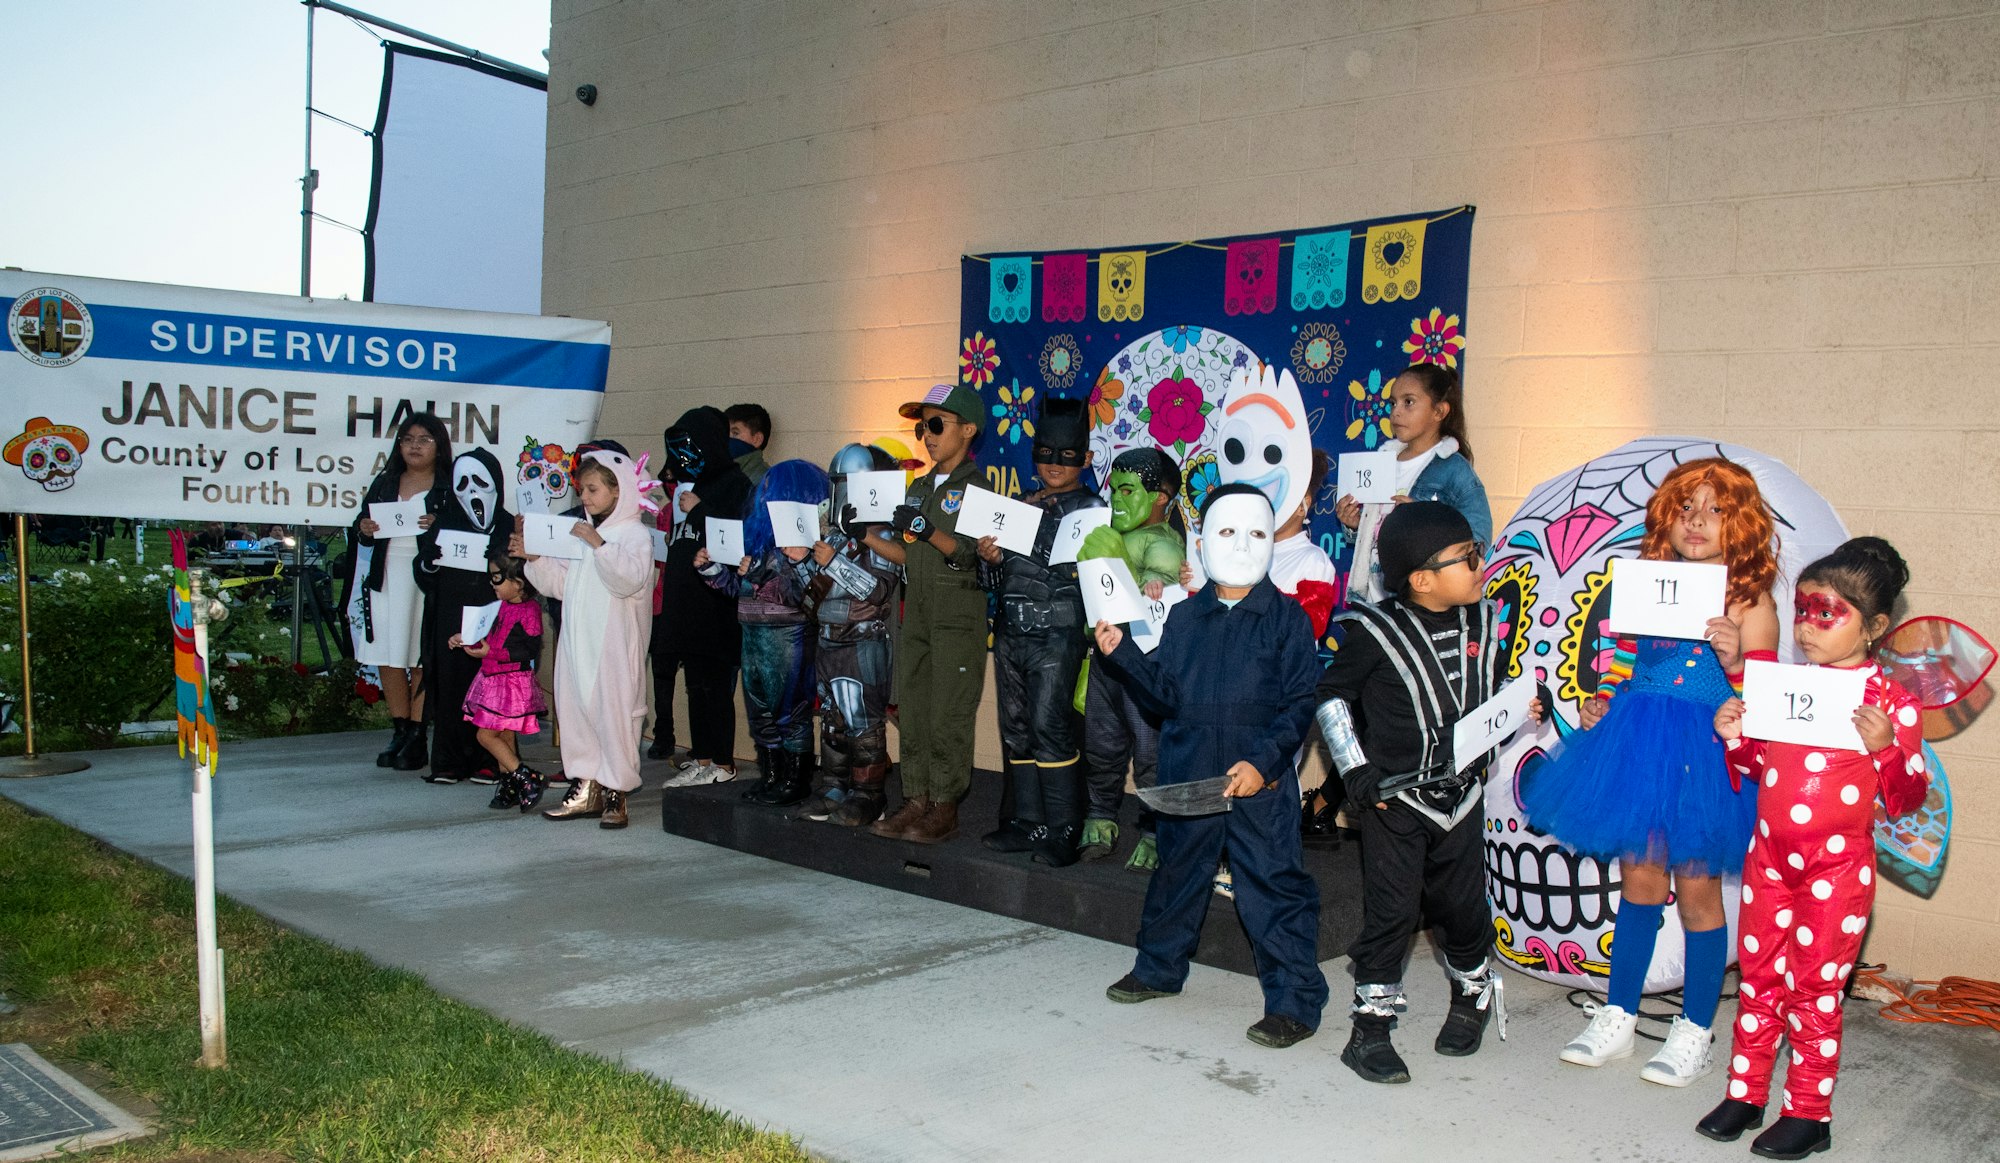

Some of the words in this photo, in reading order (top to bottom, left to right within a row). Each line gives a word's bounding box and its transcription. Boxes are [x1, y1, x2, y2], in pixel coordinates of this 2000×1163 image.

[13, 292, 35, 312] COUNTY
[64, 294, 89, 317] ANGELES
[150, 320, 457, 372] SUPERVISOR
[31, 355, 72, 365] CALIFORNIA
[102, 380, 317, 435] JANICE
[101, 437, 227, 473] County
[244, 446, 279, 471] of
[296, 448, 354, 475] Los
[986, 465, 1022, 498] DIA
[1356, 469, 1372, 488] 18
[182, 476, 289, 506] Fourth
[523, 490, 533, 506] 13
[869, 489, 878, 507] 2
[394, 513, 404, 527] 8
[796, 517, 805, 533] 6
[992, 511, 1006, 531] 4
[1071, 520, 1082, 540] 5
[547, 524, 555, 540] 1
[718, 529, 726, 545] 7
[453, 543, 468, 558] 14
[1101, 573, 1114, 596] 9
[1655, 578, 1679, 605] 11
[1148, 600, 1165, 624] 19
[1784, 692, 1814, 722] 12
[1484, 709, 1508, 738] 10
